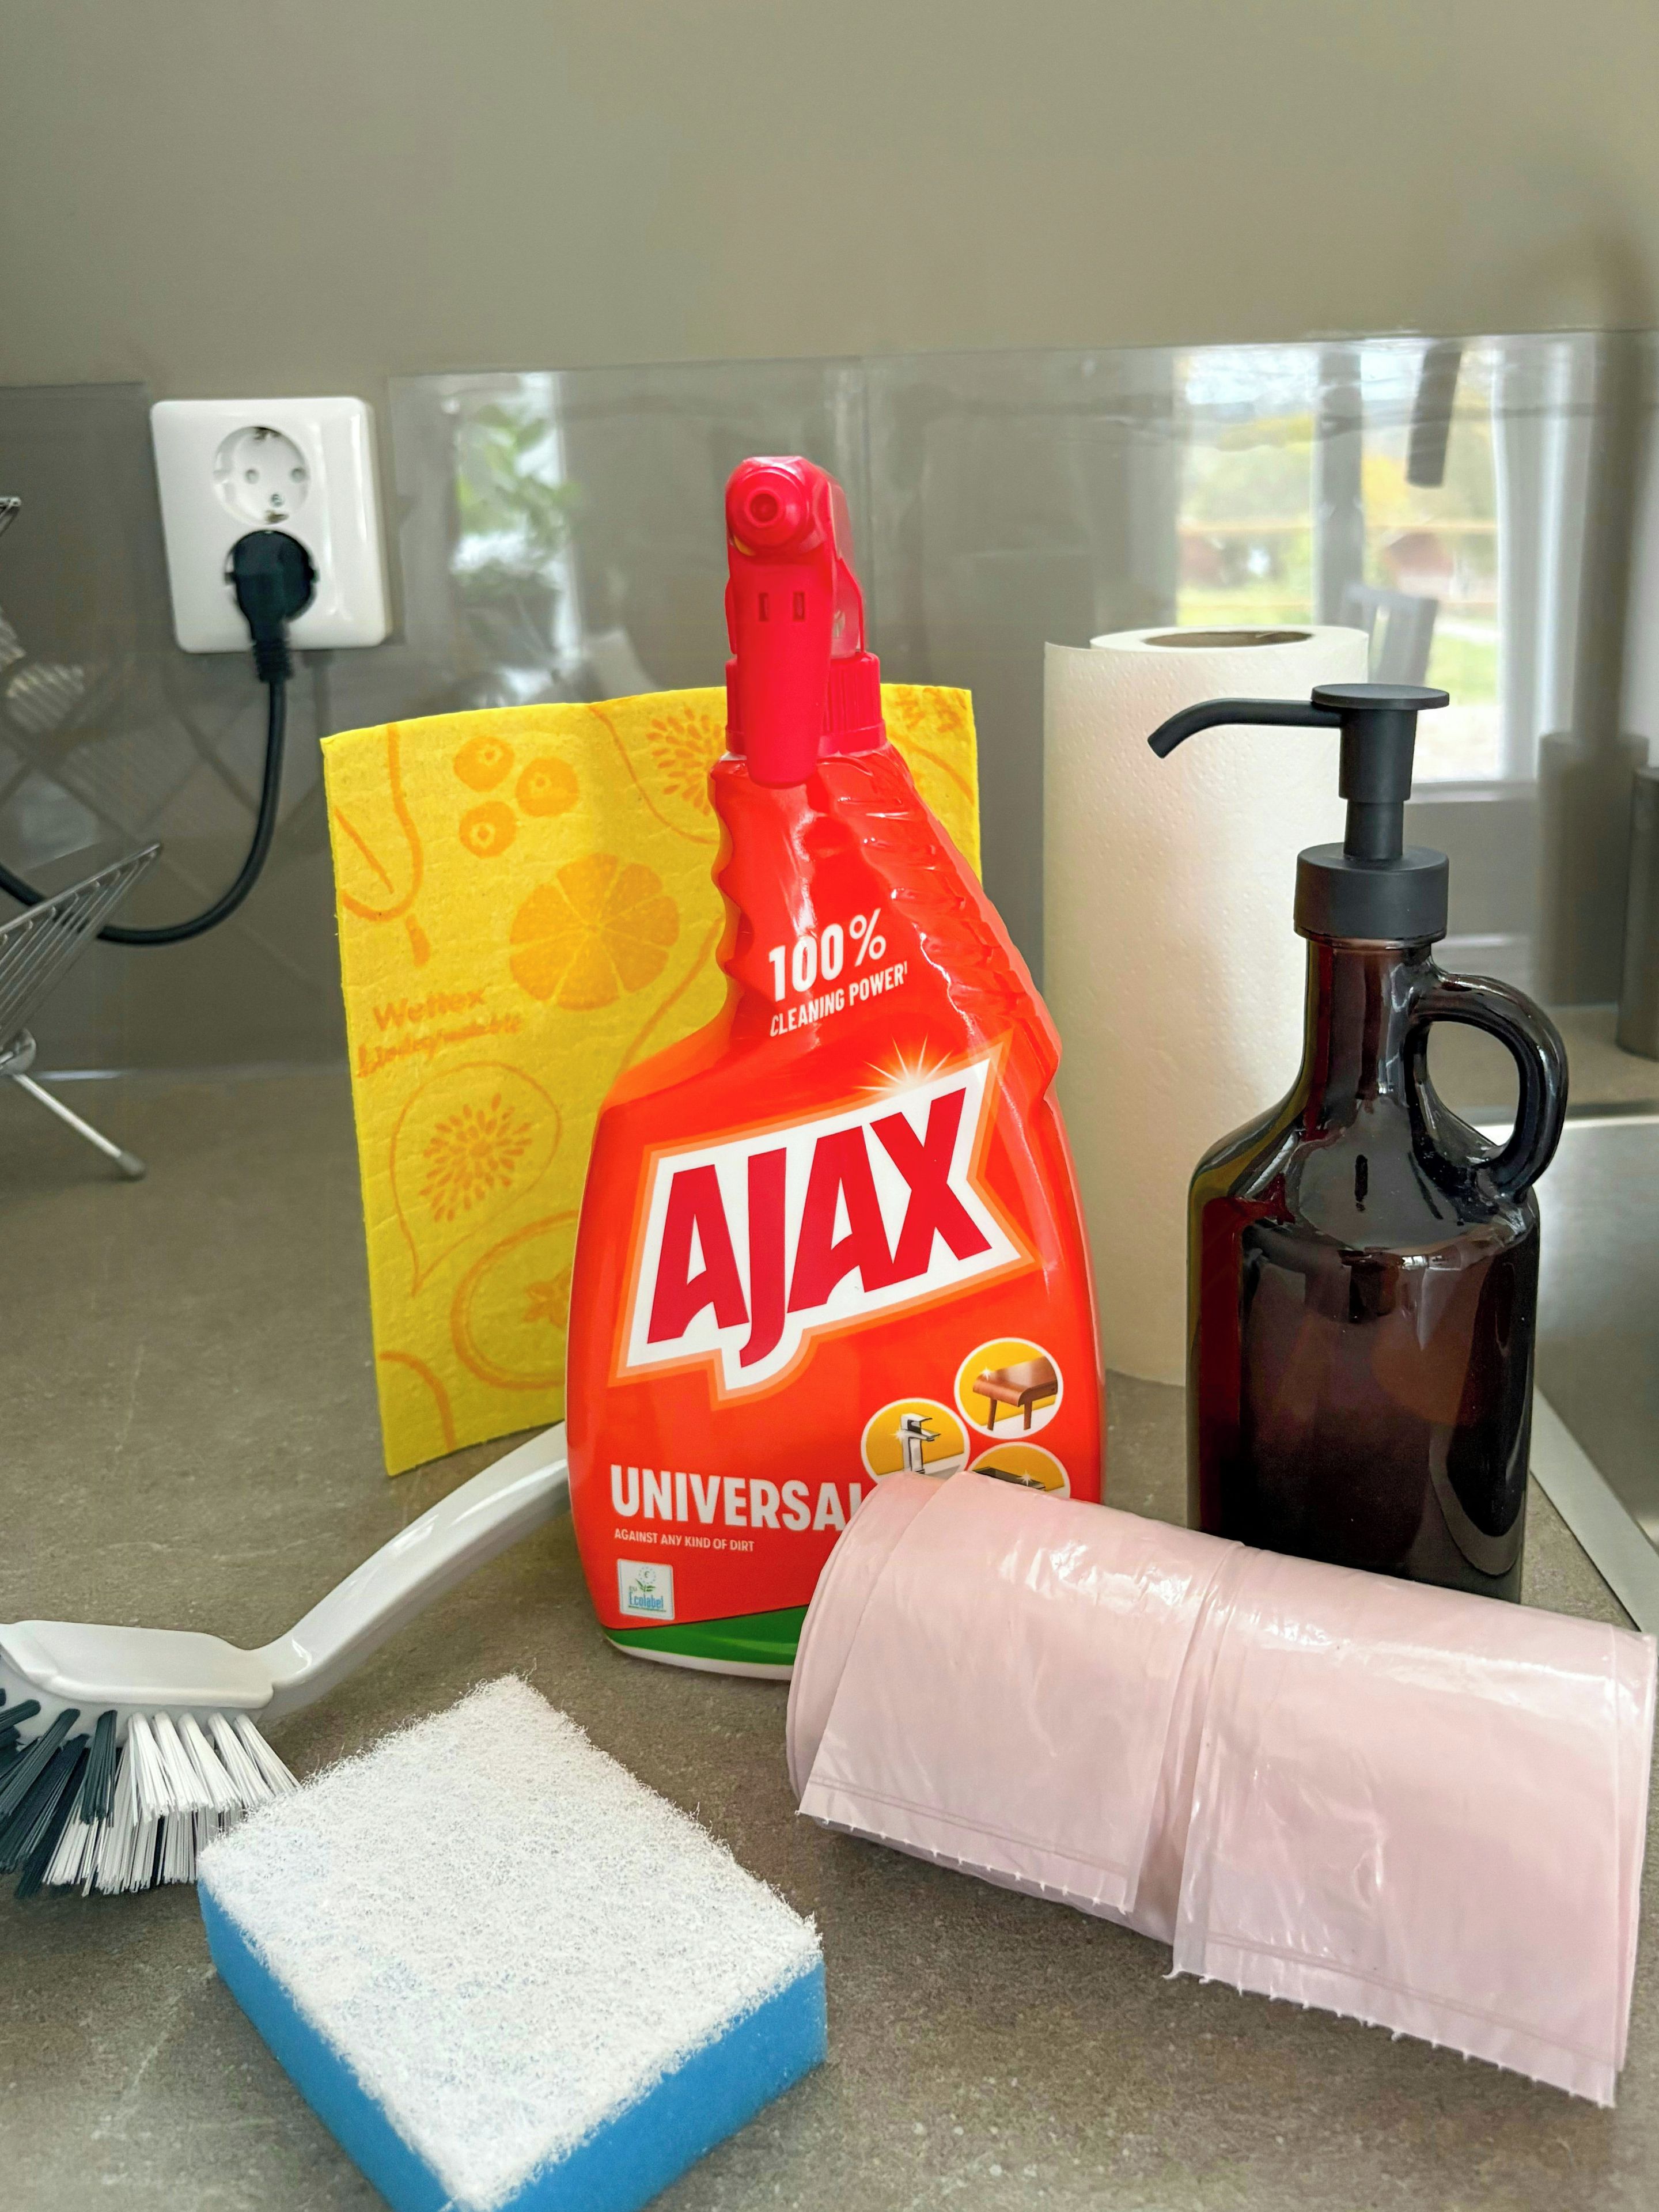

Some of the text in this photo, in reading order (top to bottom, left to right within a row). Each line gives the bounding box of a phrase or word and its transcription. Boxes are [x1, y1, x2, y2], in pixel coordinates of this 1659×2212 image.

[769, 988, 845, 1037] CLEANING
[646, 1087, 993, 1369] AJAX
[614, 1528, 755, 1552] AGAINST ANY KIND OF DIRT
[628, 1591, 664, 1609] Ecolabel
